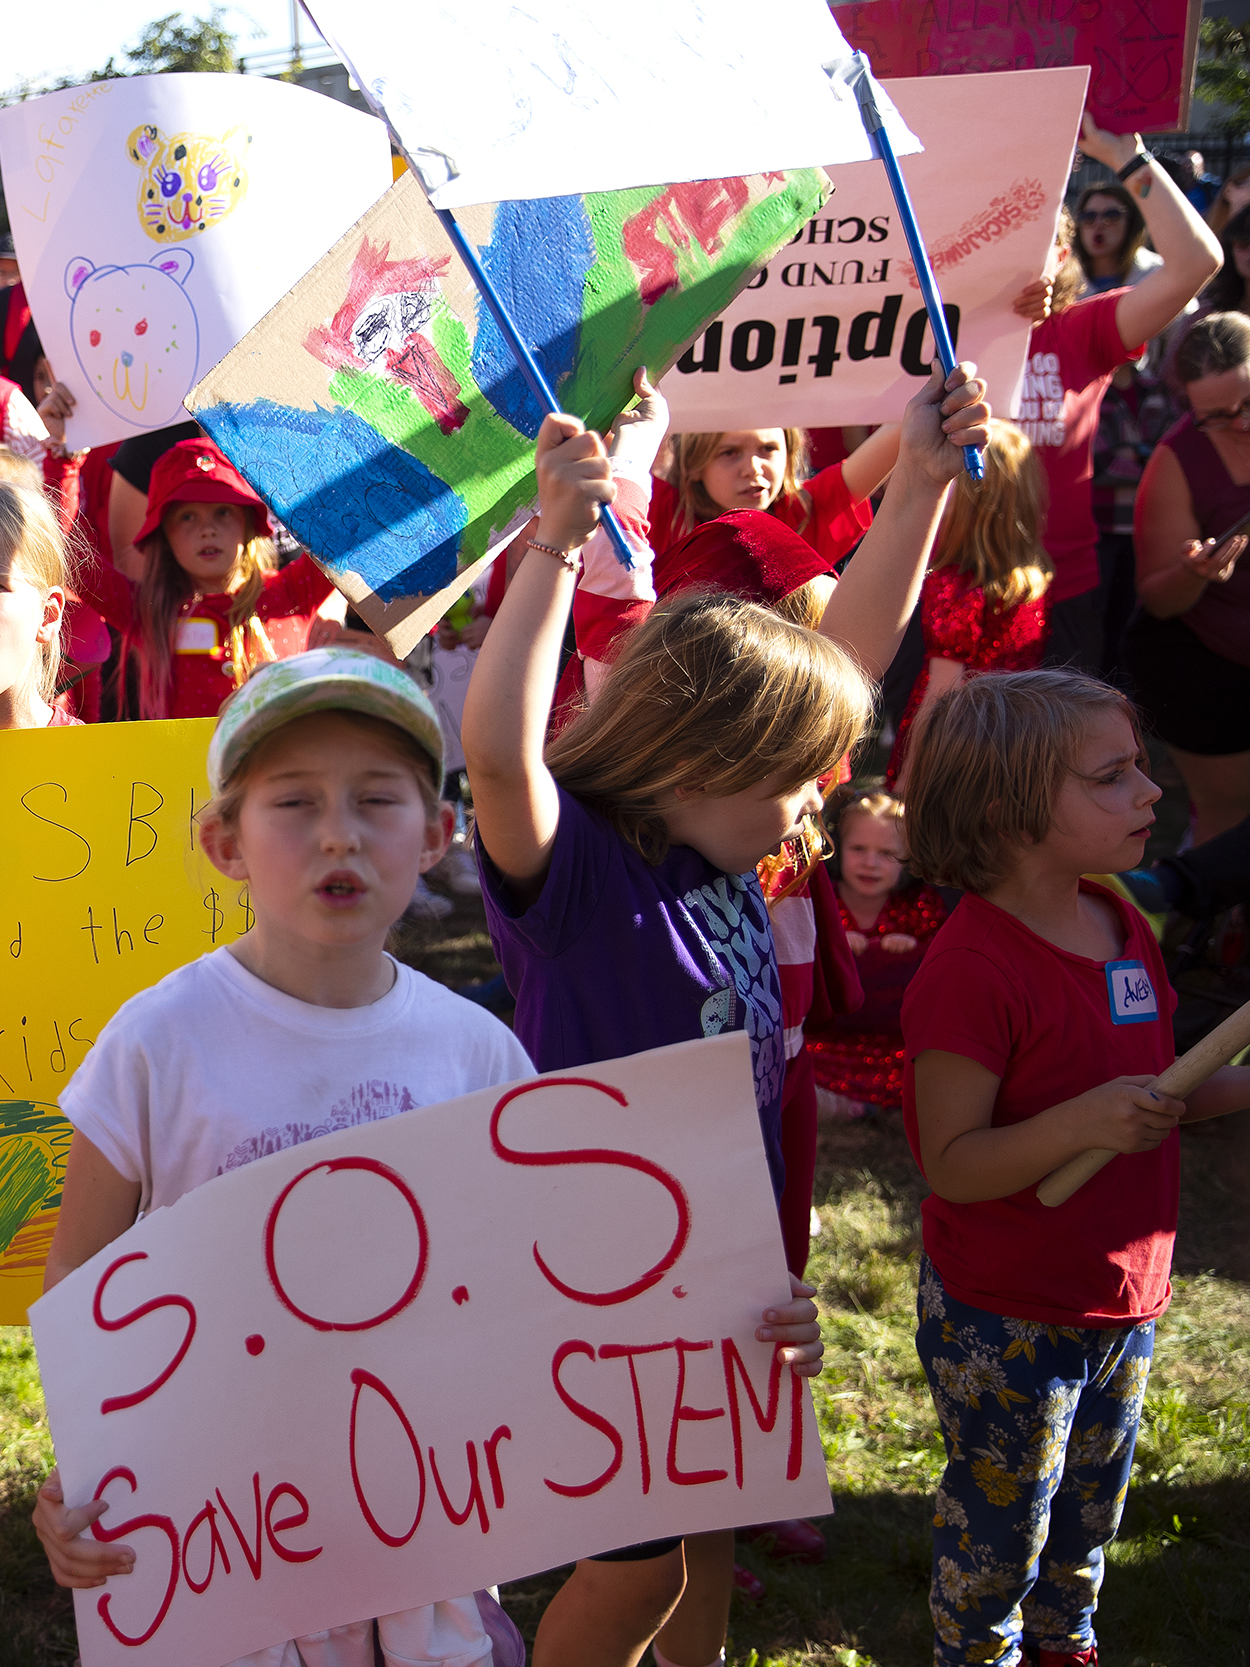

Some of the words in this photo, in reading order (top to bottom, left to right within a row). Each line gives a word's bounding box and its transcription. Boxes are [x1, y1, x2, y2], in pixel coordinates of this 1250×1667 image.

[923, 203, 1024, 275] SACAJAWE
[781, 258, 891, 287] FUND
[81, 906, 164, 963] the
[87, 1466, 323, 1646] Save
[350, 1368, 512, 1548] Our
[543, 1337, 805, 1498] STEM
